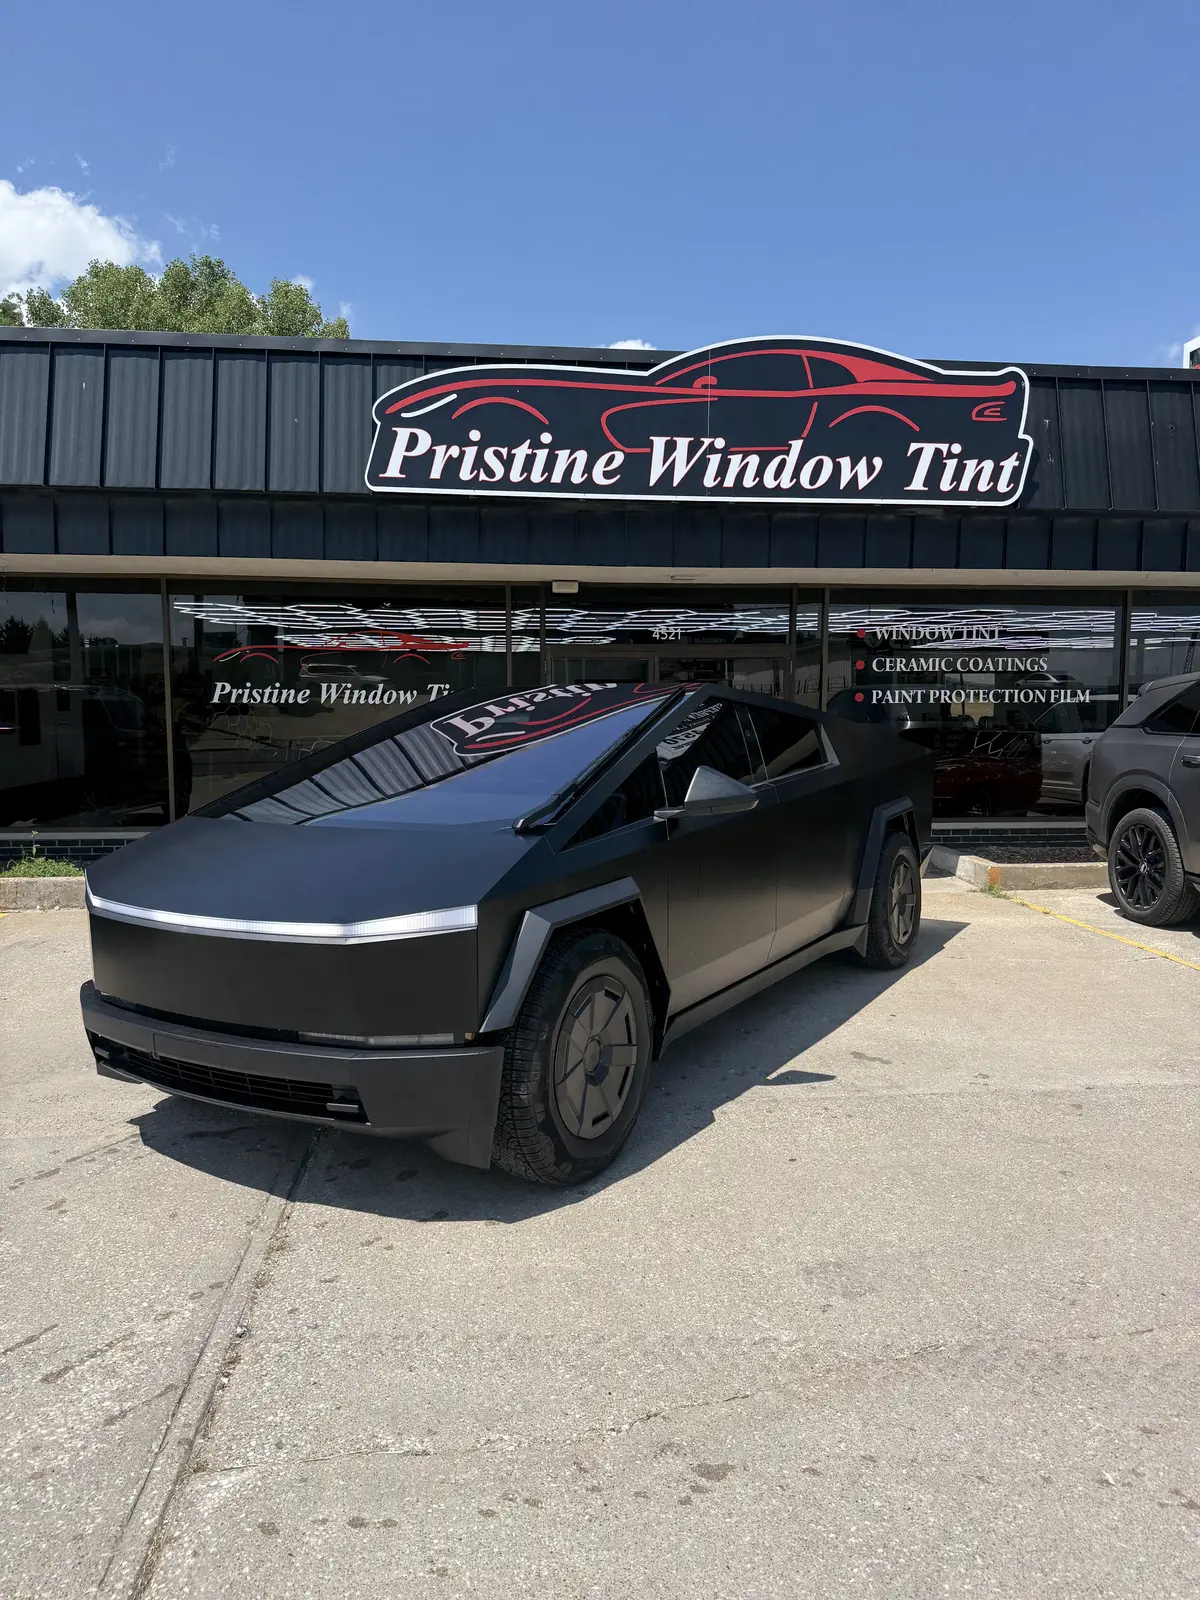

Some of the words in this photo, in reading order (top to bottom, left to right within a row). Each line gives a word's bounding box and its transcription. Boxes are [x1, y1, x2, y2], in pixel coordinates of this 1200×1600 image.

[379, 427, 624, 486] Pristine
[648, 435, 883, 491] Window
[906, 441, 1021, 493] Tint
[652, 628, 681, 640] 4521
[876, 626, 957, 640] WINDOW
[959, 626, 1003, 640] TINT
[872, 657, 953, 672] CERAMIC
[956, 657, 1048, 672] COATINGS
[210, 681, 311, 704] Pristine
[320, 682, 418, 705] Window
[427, 683, 454, 702] Ti
[871, 689, 926, 704] PAINT
[928, 689, 1047, 704] PROTECTION
[1050, 689, 1091, 704] FILM
